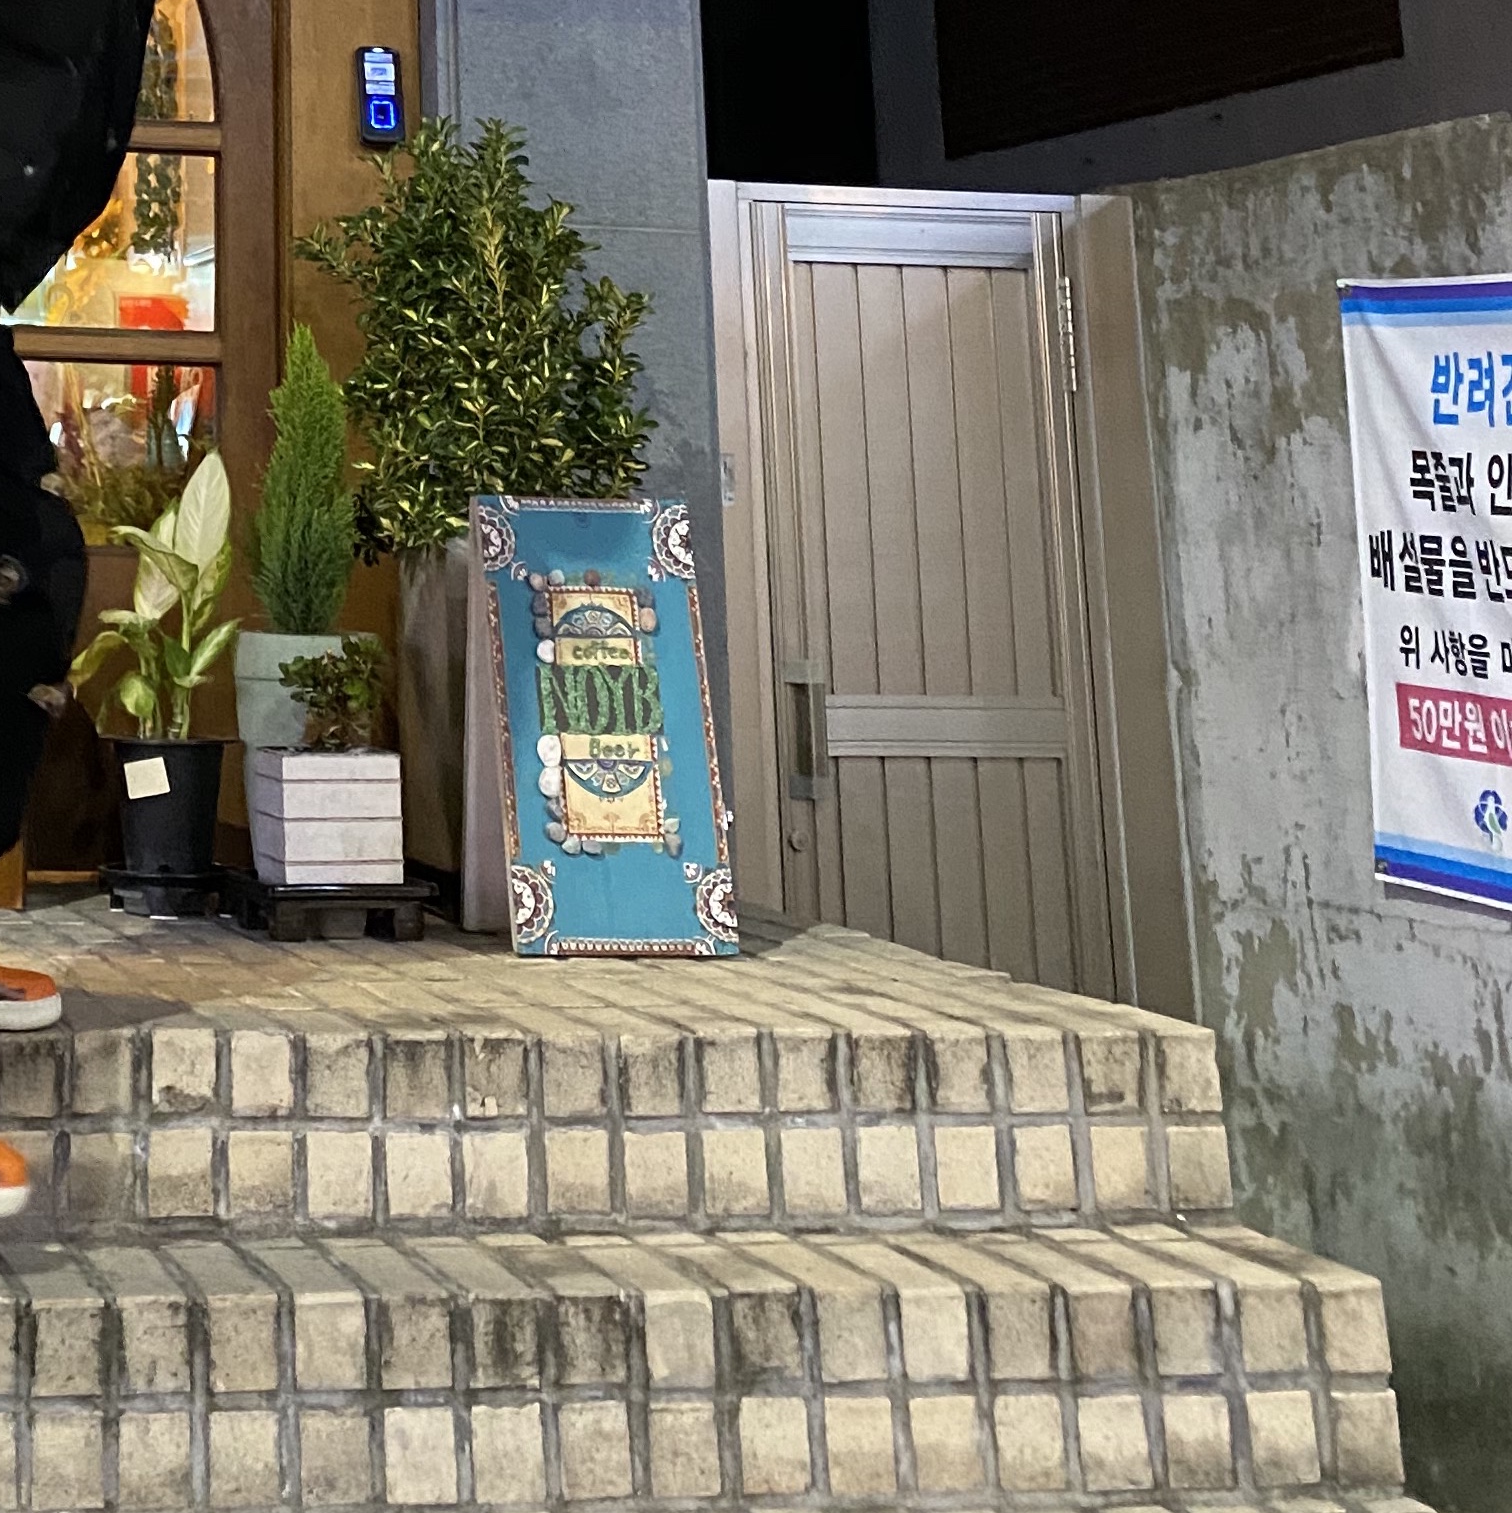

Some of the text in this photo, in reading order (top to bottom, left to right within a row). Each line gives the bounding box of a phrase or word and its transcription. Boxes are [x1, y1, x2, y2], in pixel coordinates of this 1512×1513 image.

[1410, 450, 1476, 516] 목줄과
[1399, 625, 1420, 670] 위
[1430, 629, 1490, 679] 사항을
[536, 662, 664, 736] NOYB
[1408, 696, 1488, 754] 50만원
